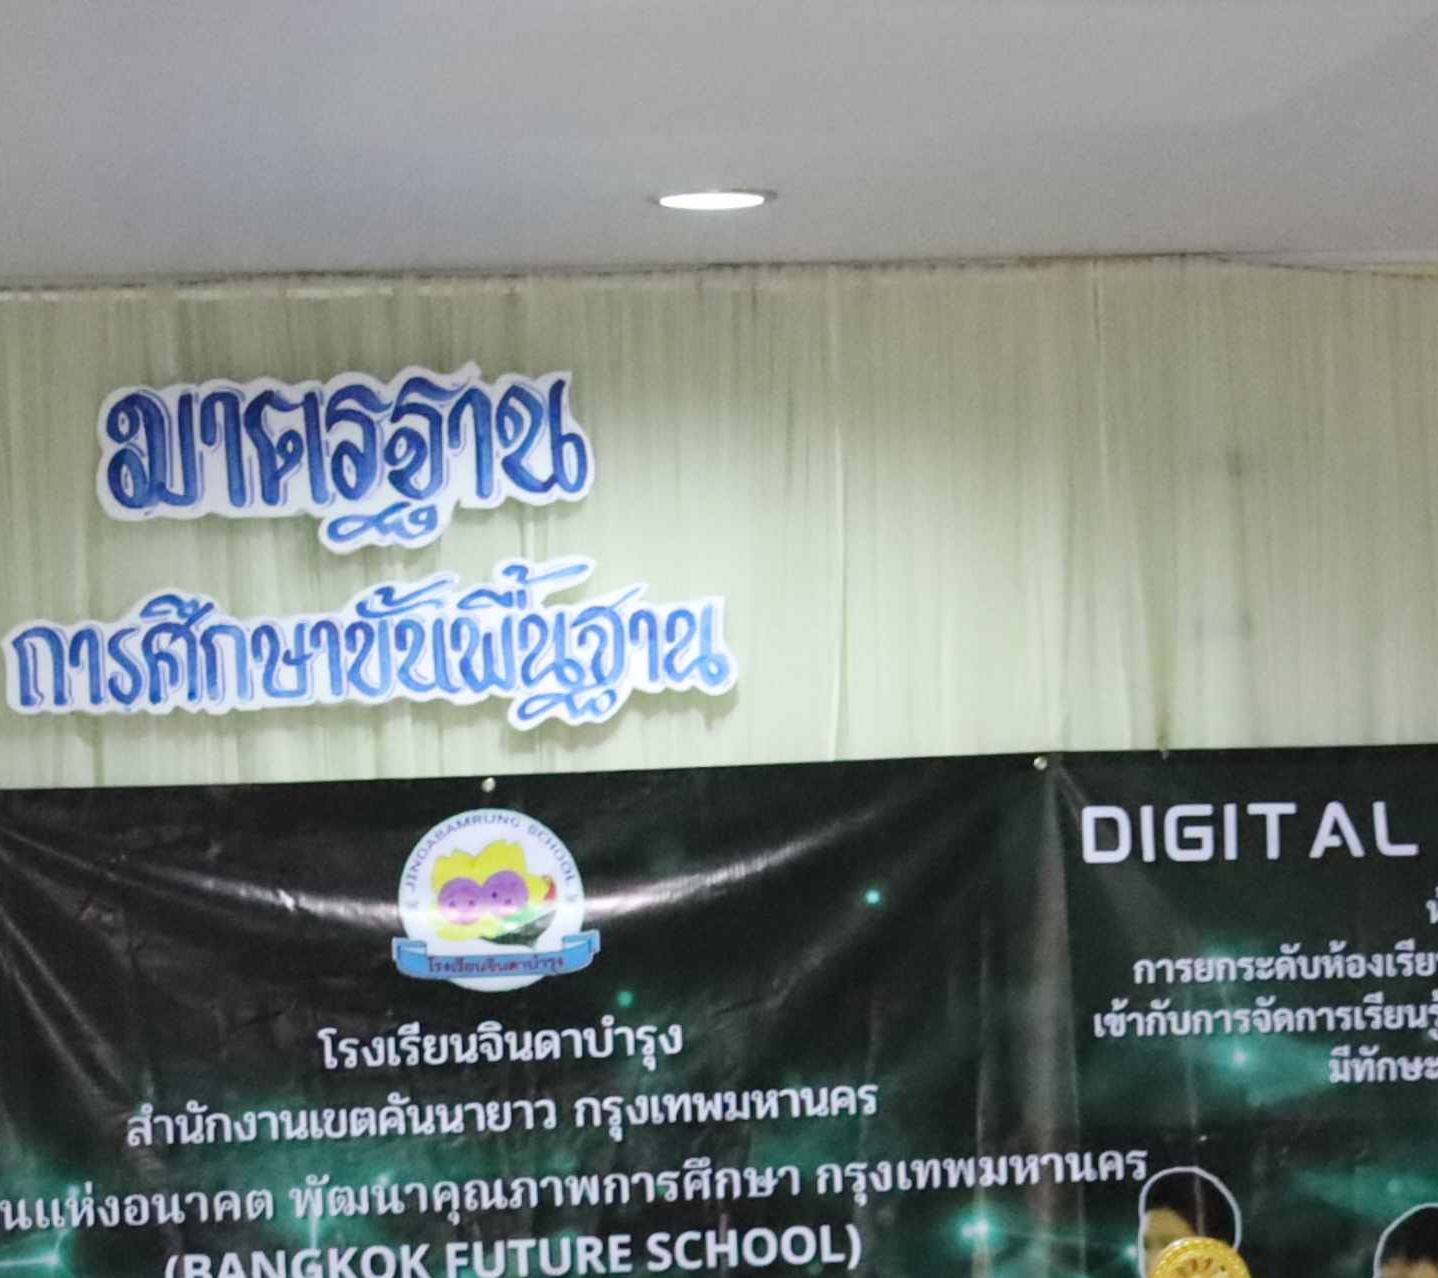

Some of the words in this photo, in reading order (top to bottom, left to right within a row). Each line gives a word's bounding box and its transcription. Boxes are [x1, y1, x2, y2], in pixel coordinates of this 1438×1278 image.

[104, 372, 592, 542] มาตรฐาน
[12, 560, 732, 722] การศึกษาขั้นพื้นฐาน
[404, 813, 522, 889] JINDABAMRUNG
[527, 823, 576, 887] SCHOOL
[1081, 801, 1419, 864] DIGITAL
[317, 1016, 685, 1074] โรงเรียนจินดาบำรุง
[125, 1088, 559, 1153] สำนักงานเขตคันนายาว
[571, 1076, 880, 1142] กรุงเทพมหานคร
[289, 1156, 804, 1229] พัฒนาคุณภาพการศึกษา
[814, 1141, 1150, 1208] กรุงเทพมหานคร
[645, 1219, 864, 1275] SCHOOL)
